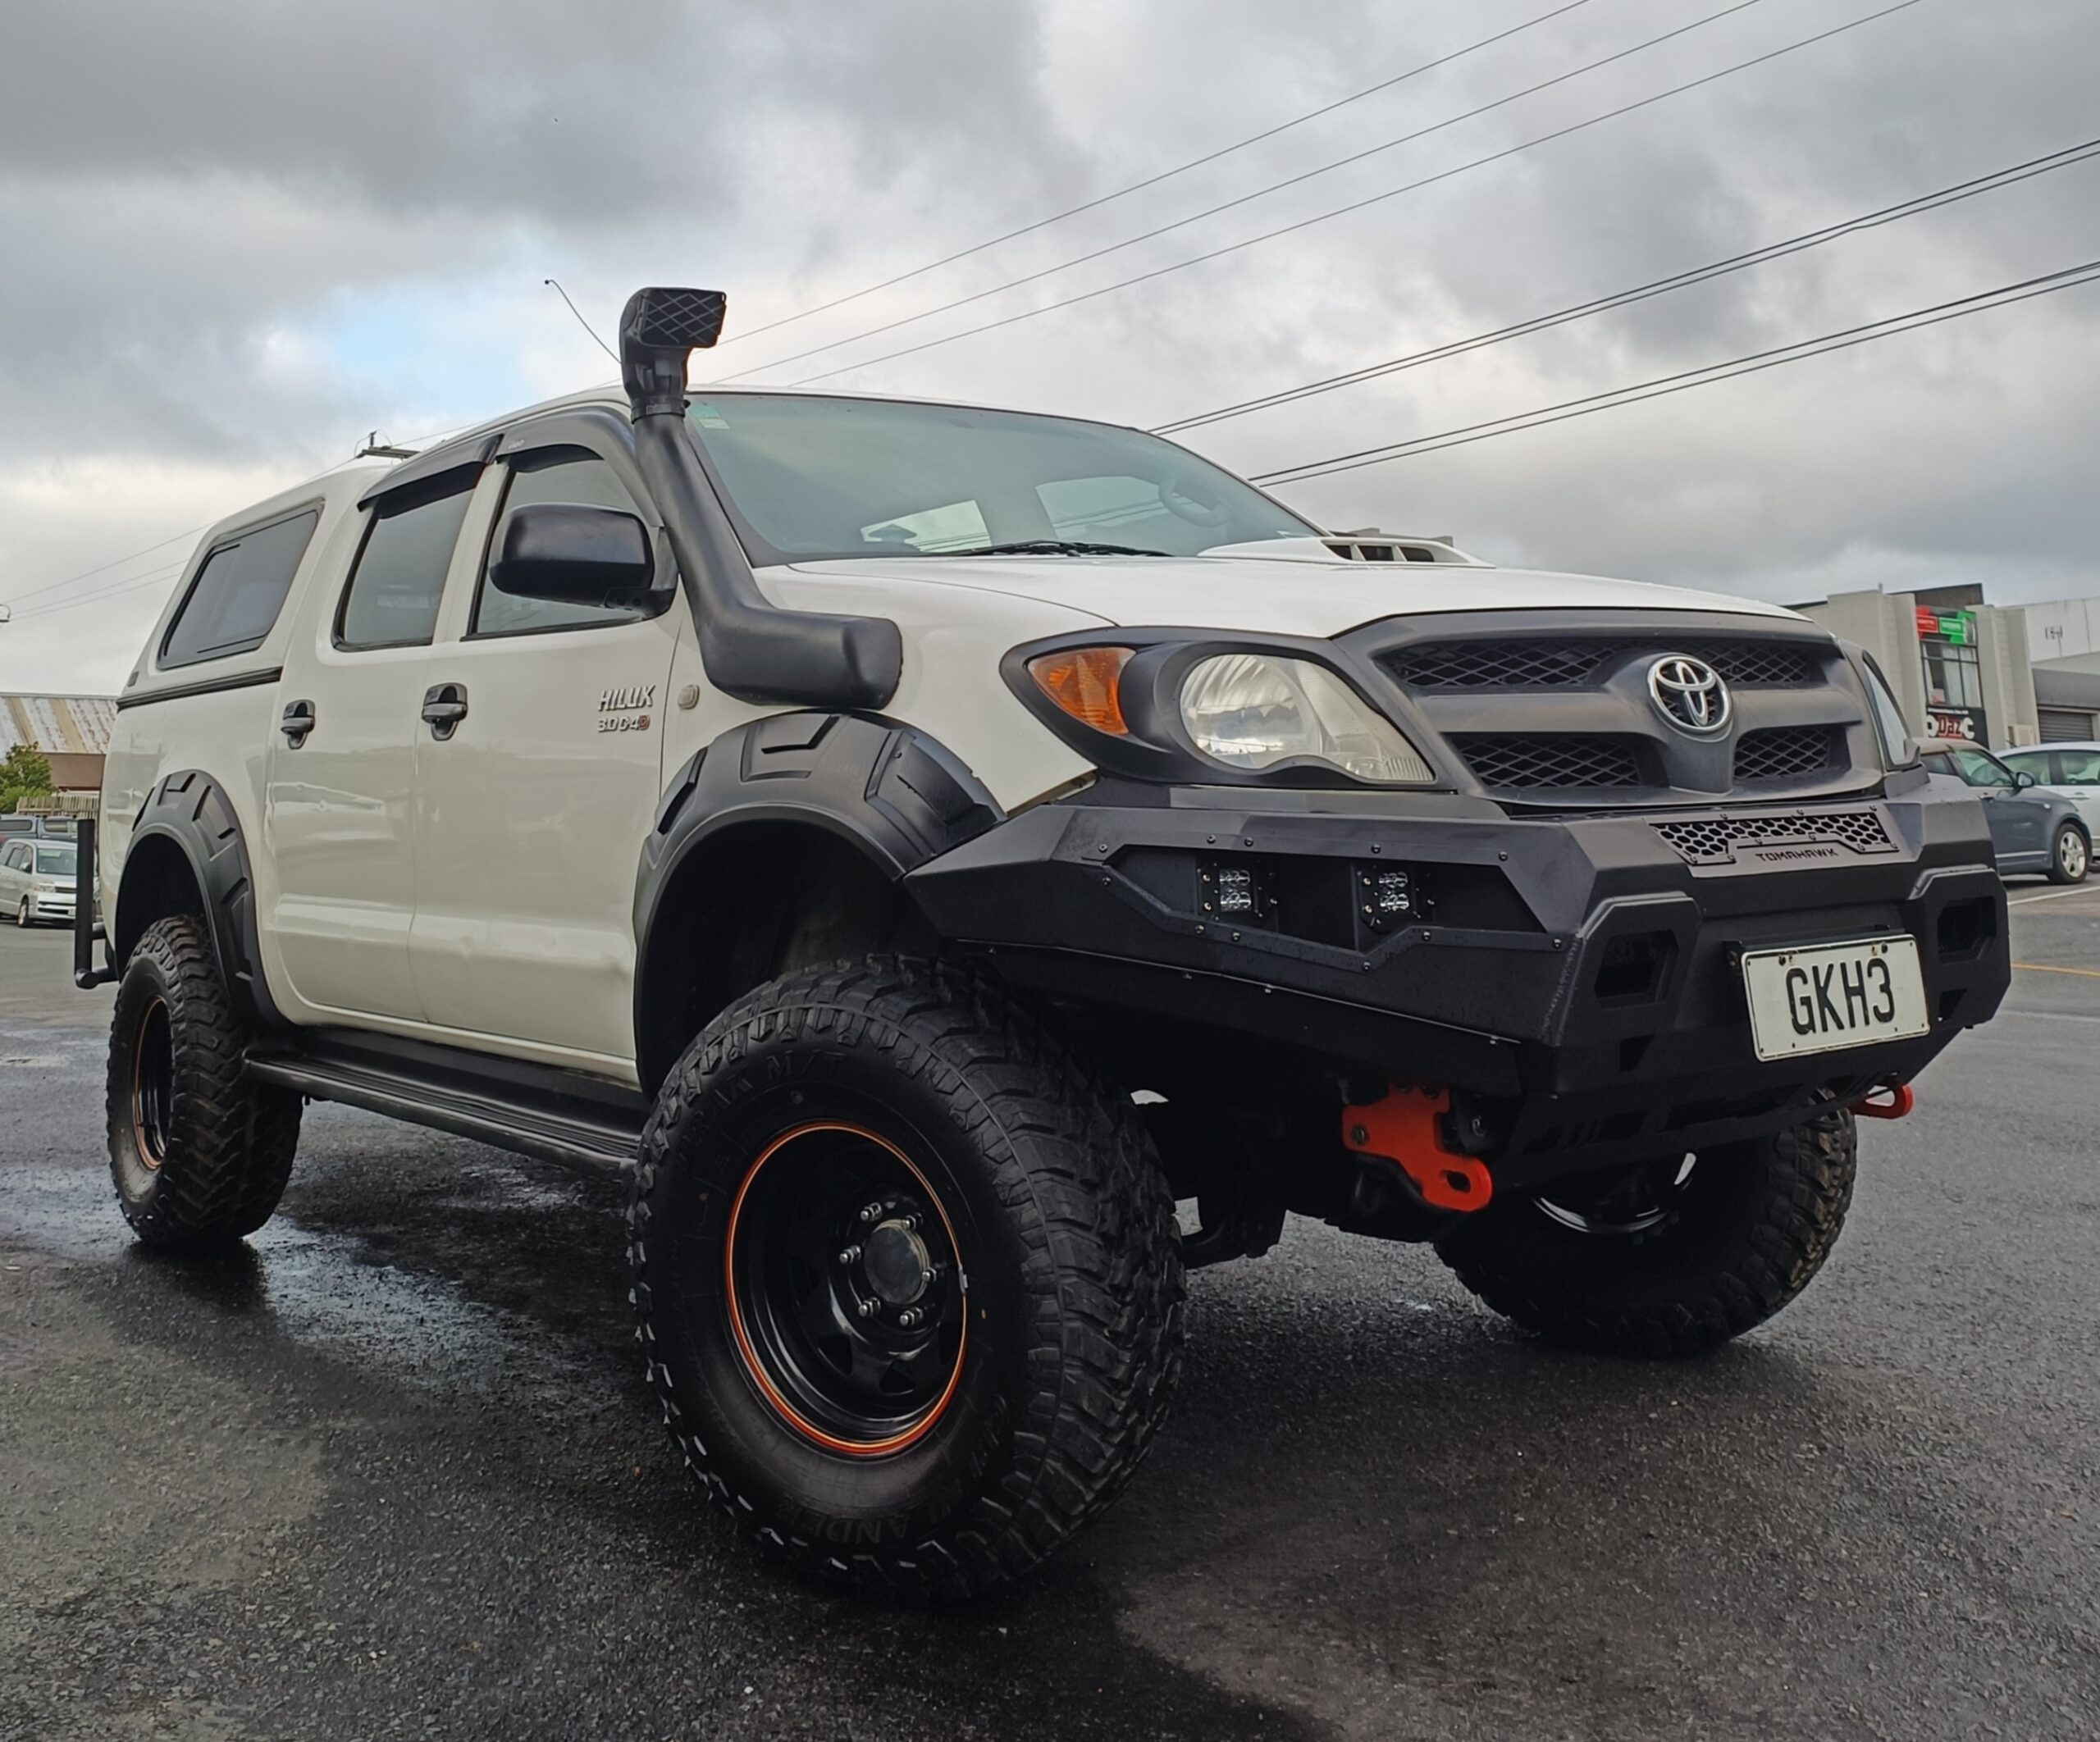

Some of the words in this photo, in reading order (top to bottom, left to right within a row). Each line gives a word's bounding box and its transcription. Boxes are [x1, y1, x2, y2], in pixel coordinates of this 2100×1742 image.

[598, 685, 655, 711] HILUX
[1755, 848, 1838, 862] TOMAHAWK
[1786, 957, 1895, 1035] GKH3
